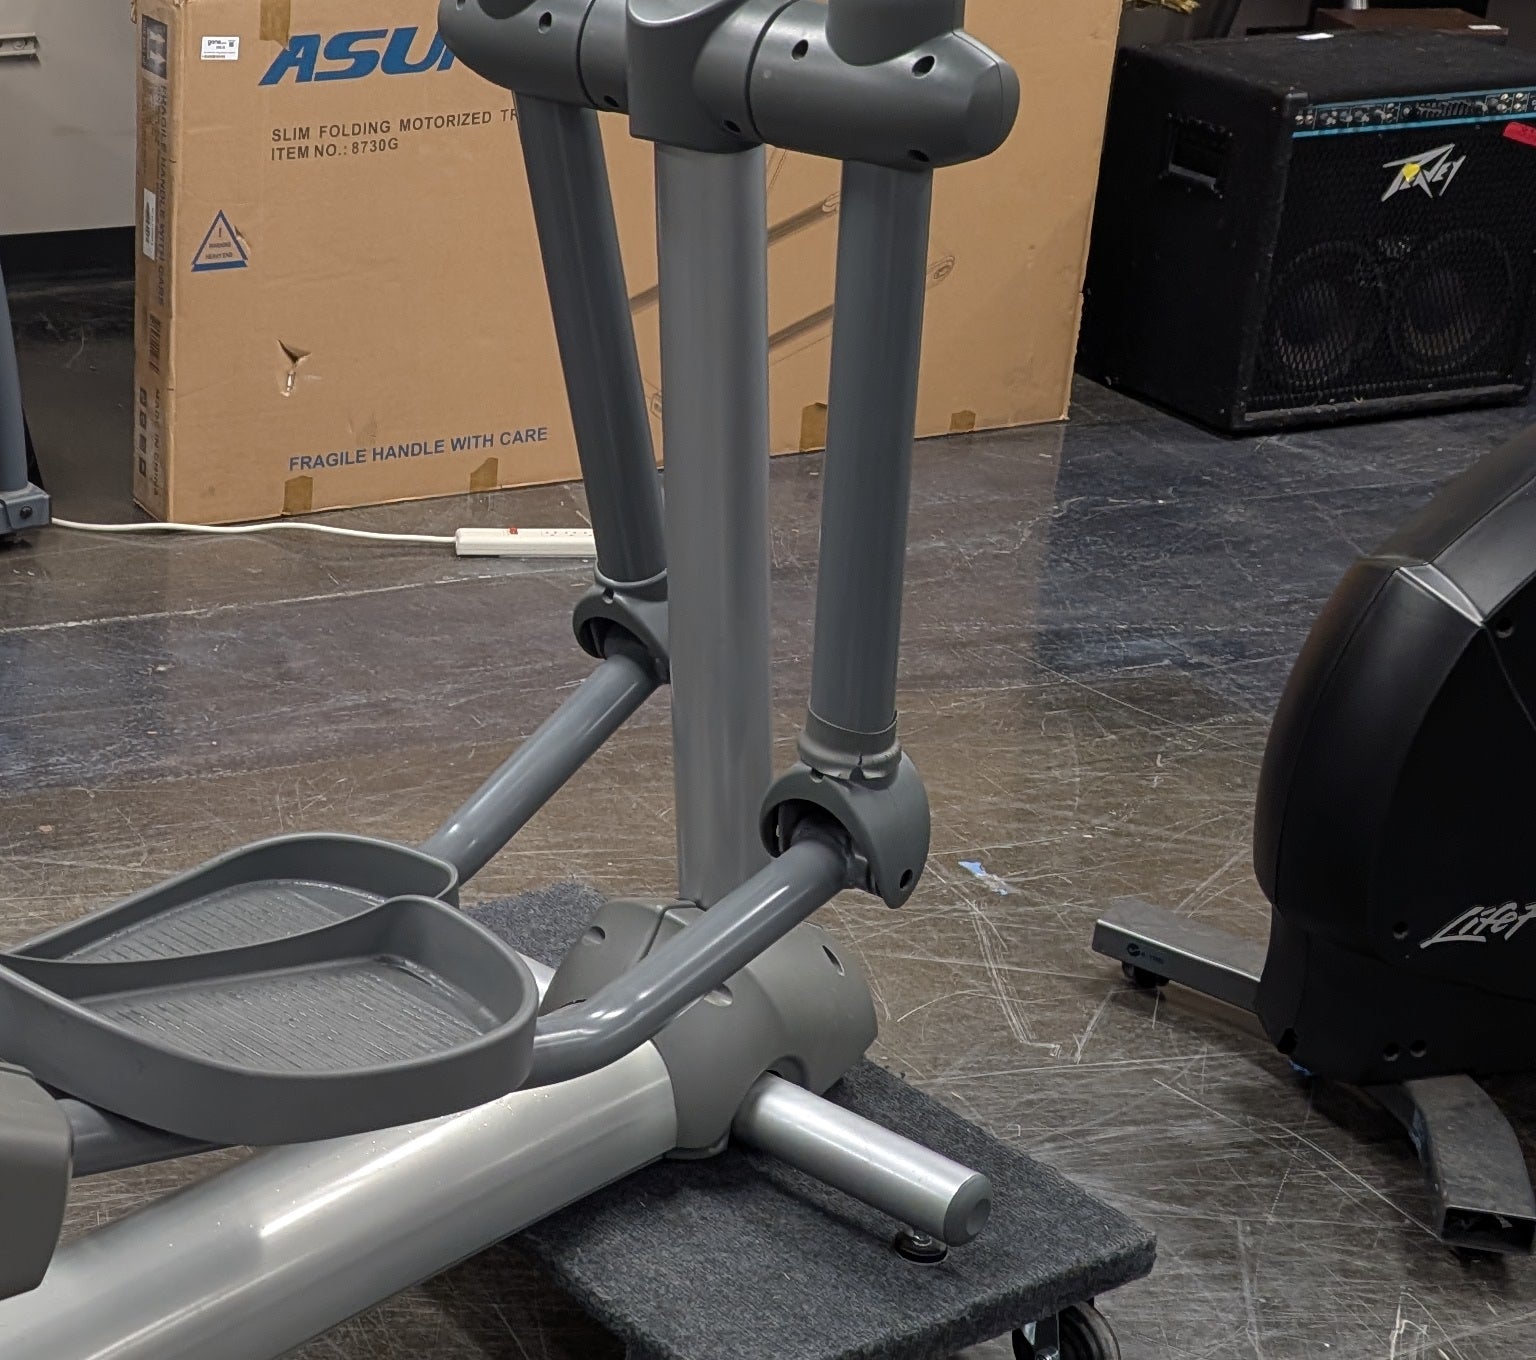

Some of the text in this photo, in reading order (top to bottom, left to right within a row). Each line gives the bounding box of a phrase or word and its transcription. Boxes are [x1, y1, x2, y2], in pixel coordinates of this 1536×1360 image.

[272, 126, 311, 143] SLIM
[319, 120, 392, 139] FOLDING
[399, 110, 493, 132] MOTORIZED
[272, 137, 400, 161] ITEM NO.: 8730G
[288, 425, 549, 473] FRAGILE HANDLE WITH CARE
[1420, 902, 1518, 949] Life
